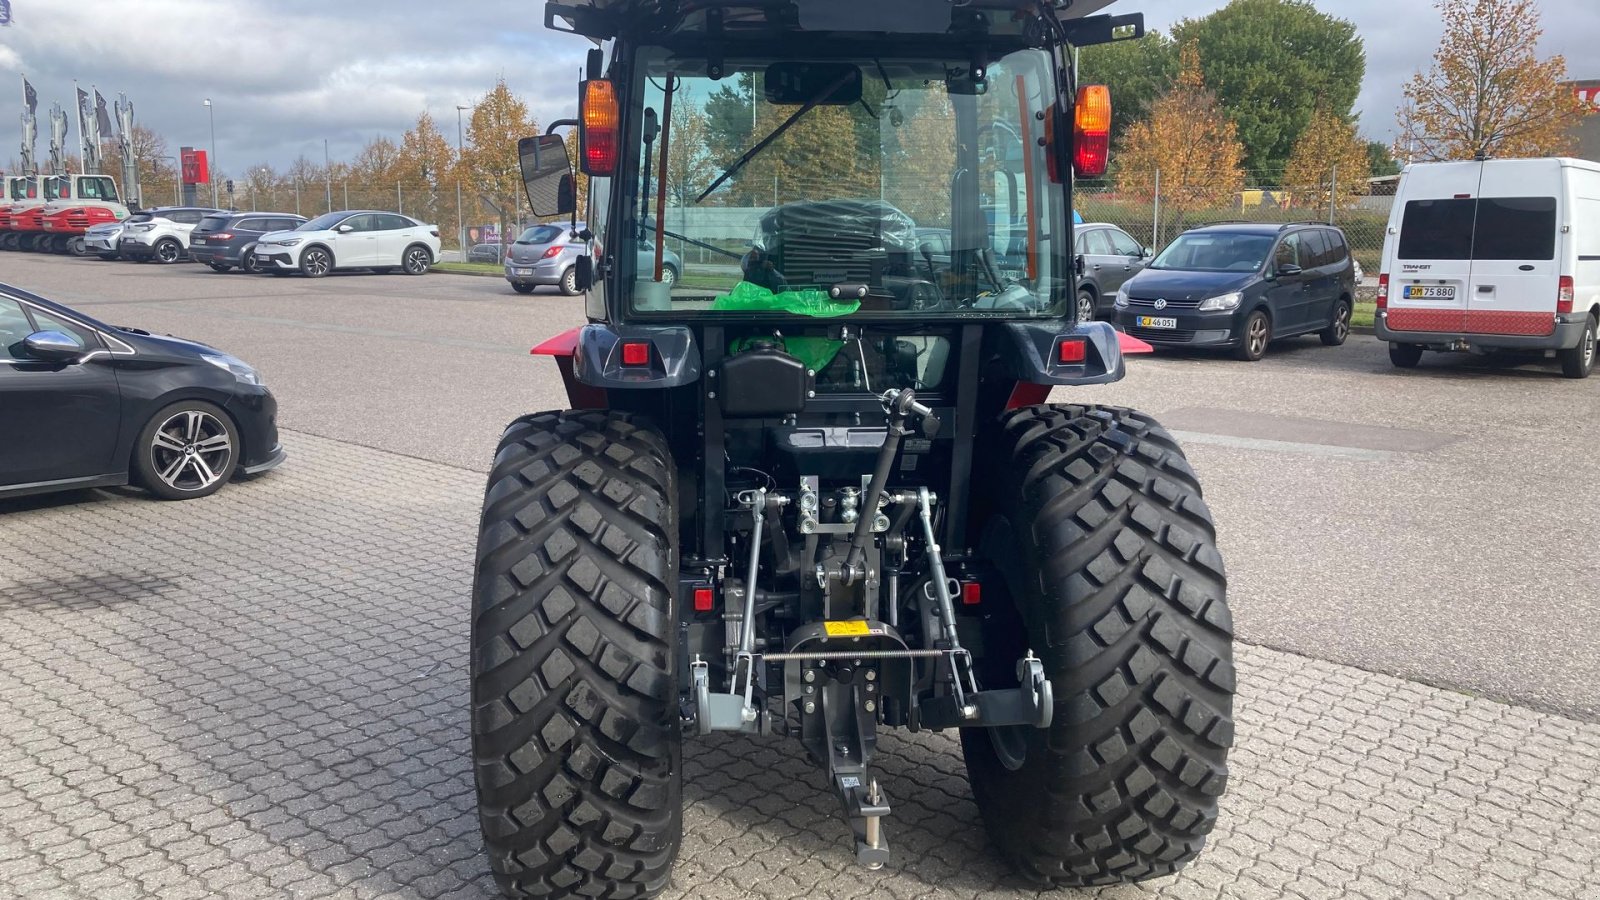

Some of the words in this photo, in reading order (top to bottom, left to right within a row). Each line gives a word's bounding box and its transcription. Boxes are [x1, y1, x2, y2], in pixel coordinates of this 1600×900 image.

[1410, 288, 1423, 296] DM
[1424, 288, 1435, 296] 75
[1436, 288, 1453, 297] 880
[1152, 318, 1161, 327] 46
[1161, 319, 1175, 328] 051
